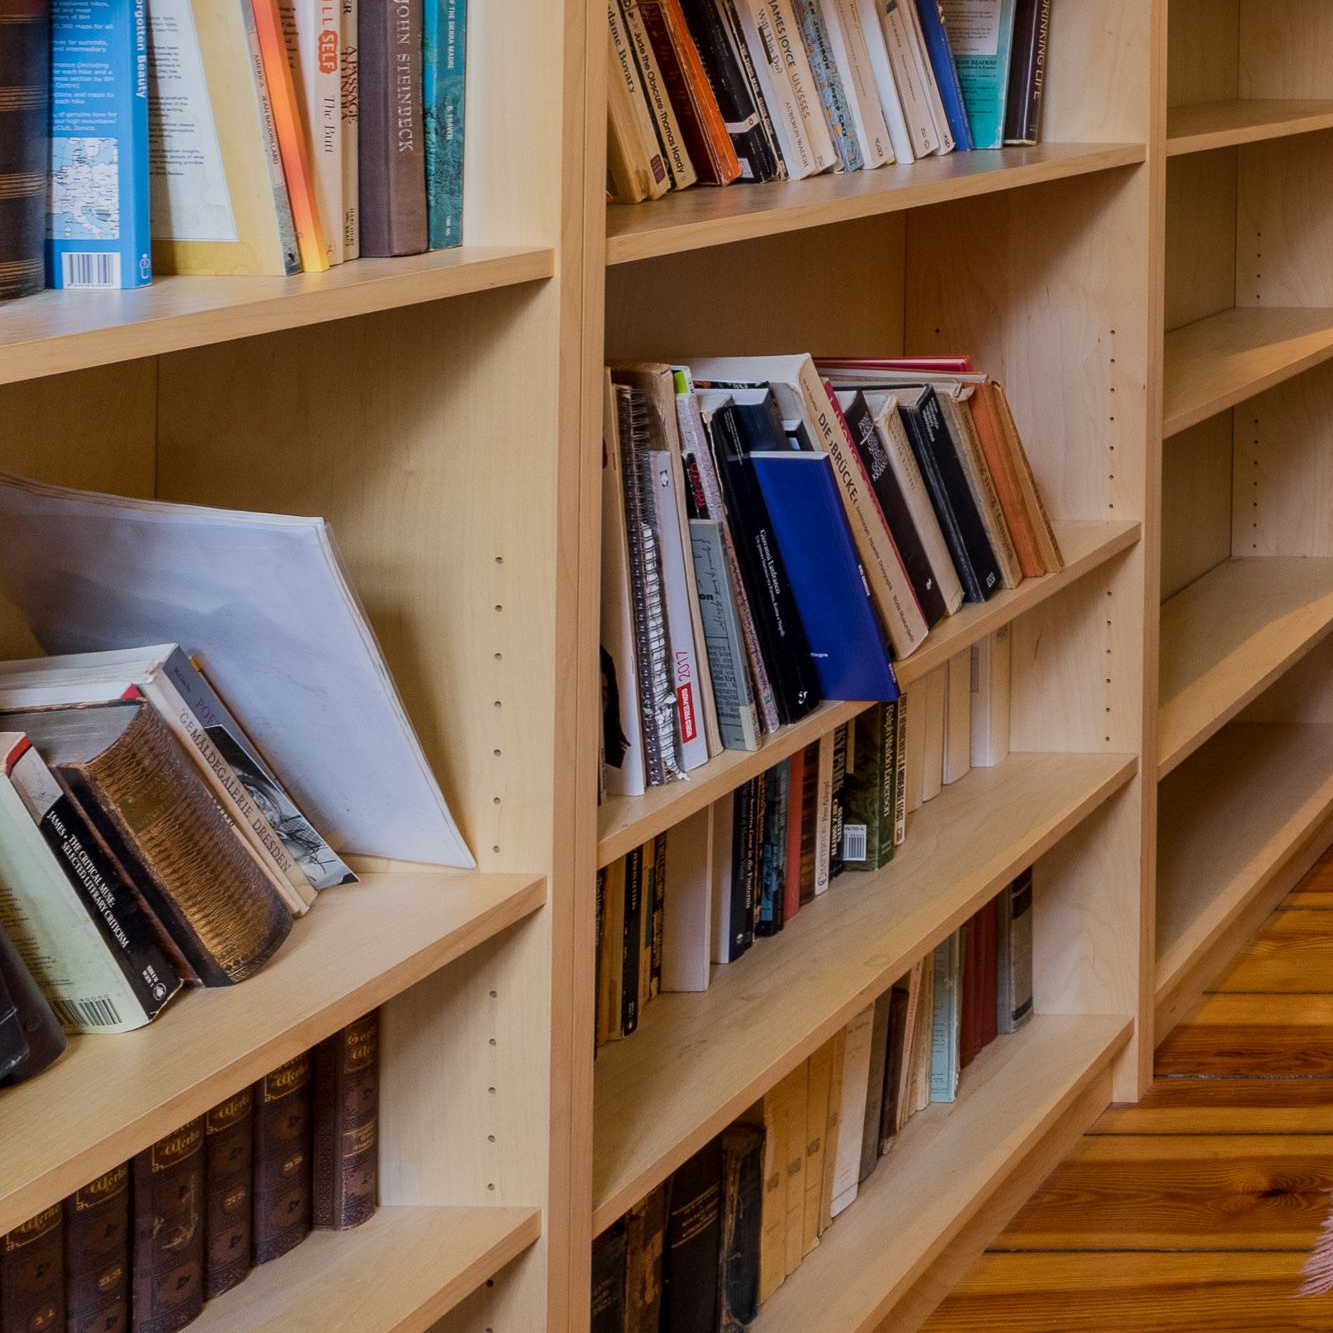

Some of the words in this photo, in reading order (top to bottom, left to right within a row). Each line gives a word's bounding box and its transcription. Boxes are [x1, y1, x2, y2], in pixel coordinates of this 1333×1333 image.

[322, 32, 336, 70] SELF
[447, 21, 456, 45] SIERRA
[608, 5, 622, 48] dame
[618, 49, 637, 94] Bovary
[633, 32, 648, 55] Jude
[757, 8, 769, 37] Will
[763, 32, 777, 56] This
[771, 55, 784, 75] Do?
[812, 17, 831, 70] JOHNSON
[136, 54, 148, 99] Beauty
[447, 46, 456, 70] MADRE
[639, 54, 651, 72] the
[348, 55, 359, 124] PASSAGE
[647, 70, 665, 111] Obscure
[777, 34, 796, 68] JOYCE
[791, 73, 811, 120] ULYSSES
[1033, 68, 1044, 101] LIFE
[254, 53, 265, 89] AMERICA
[265, 114, 279, 166] BAUDRILLARD
[323, 97, 336, 122] The
[396, 52, 414, 153] STEINBECK
[323, 125, 336, 153] Butt
[659, 111, 676, 148] Thomas
[670, 143, 686, 174] Hardy
[818, 412, 833, 442] DIE
[759, 529, 774, 565] Giovanni
[766, 562, 781, 596] Lanfranco
[674, 650, 692, 683] 2017
[884, 704, 896, 736] Ralph
[884, 735, 895, 768] Waldo
[832, 751, 846, 795] PARK
[179, 711, 254, 819] GEMÄLDEGALERIE
[251, 818, 292, 874] DRESDEN
[882, 768, 893, 817] Emerson
[46, 809, 67, 839] JAMES
[68, 833, 83, 853] THE
[78, 848, 103, 888] CRITICAL
[60, 841, 87, 881] SELECTED
[82, 877, 108, 915] LITERARY
[103, 908, 130, 949] CRITICISM
